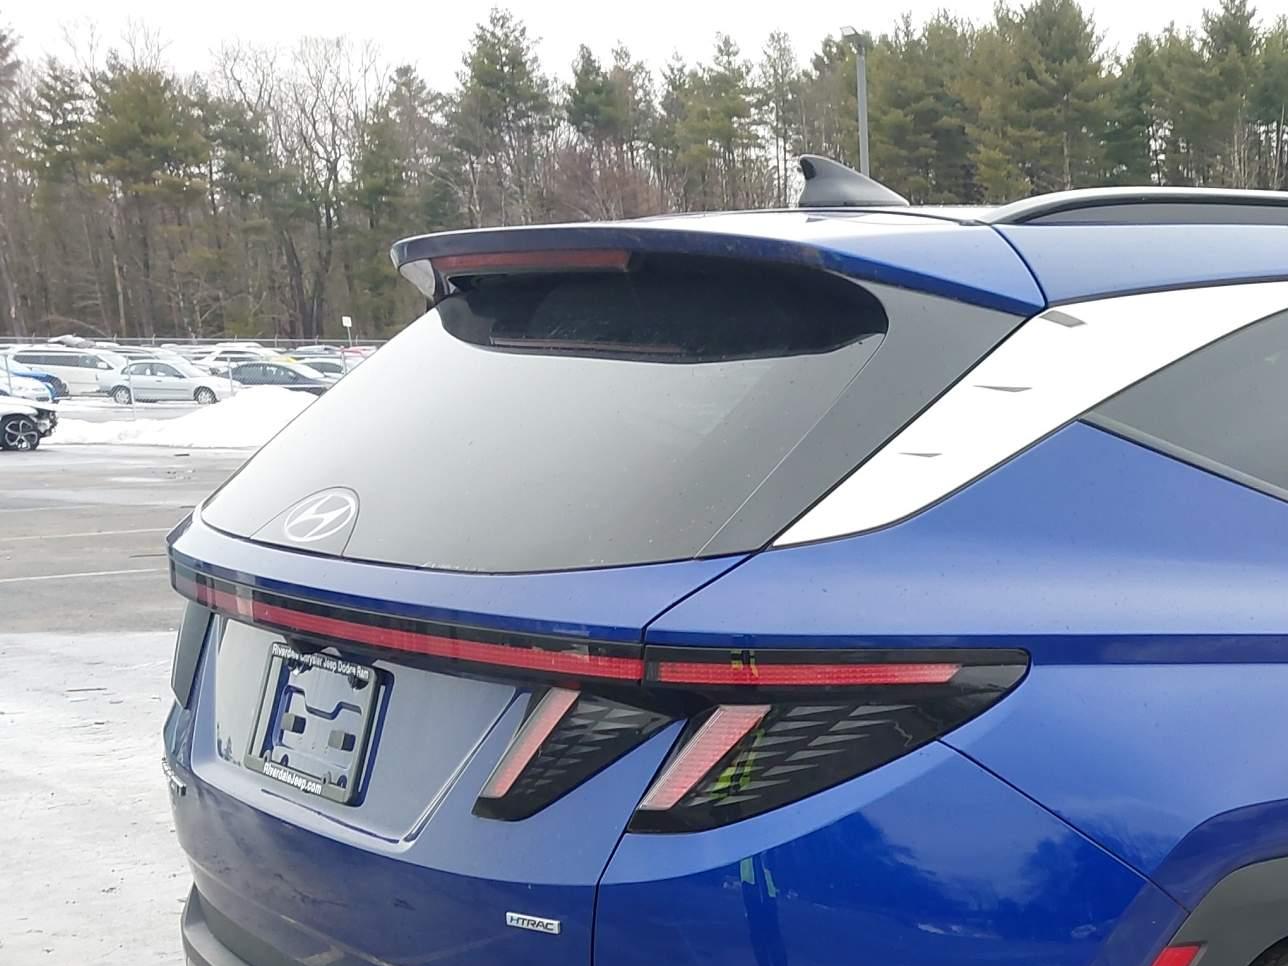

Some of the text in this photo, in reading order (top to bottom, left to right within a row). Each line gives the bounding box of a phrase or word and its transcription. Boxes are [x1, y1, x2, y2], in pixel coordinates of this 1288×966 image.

[323, 656, 337, 672] Jeep
[356, 665, 369, 680] Ram
[263, 762, 322, 795] RiverdaleJeep.com
[510, 915, 554, 931] HTRAC
